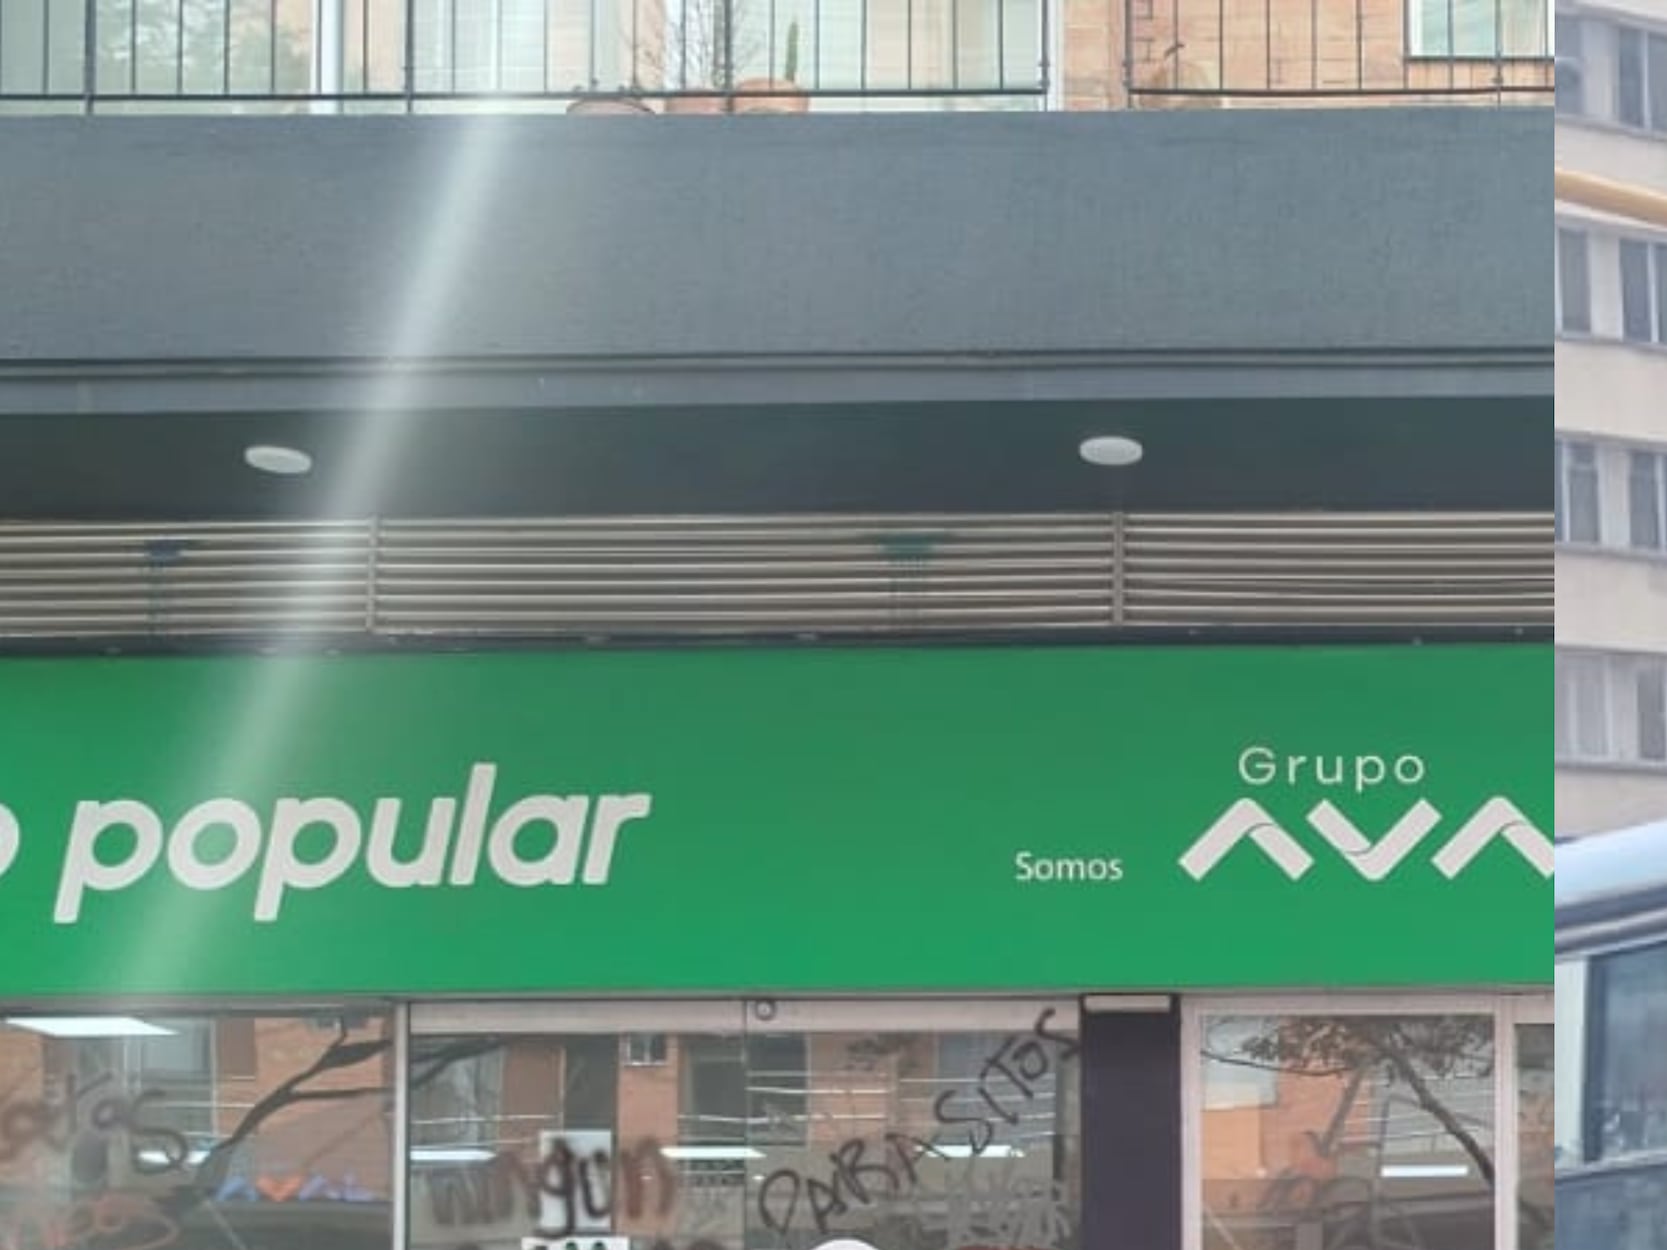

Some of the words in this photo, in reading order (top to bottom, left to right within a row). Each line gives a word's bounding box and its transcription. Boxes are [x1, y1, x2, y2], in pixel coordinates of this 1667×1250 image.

[1237, 746, 1426, 793] Grupo
[52, 762, 652, 925] popular
[1014, 850, 1125, 883] Somos
